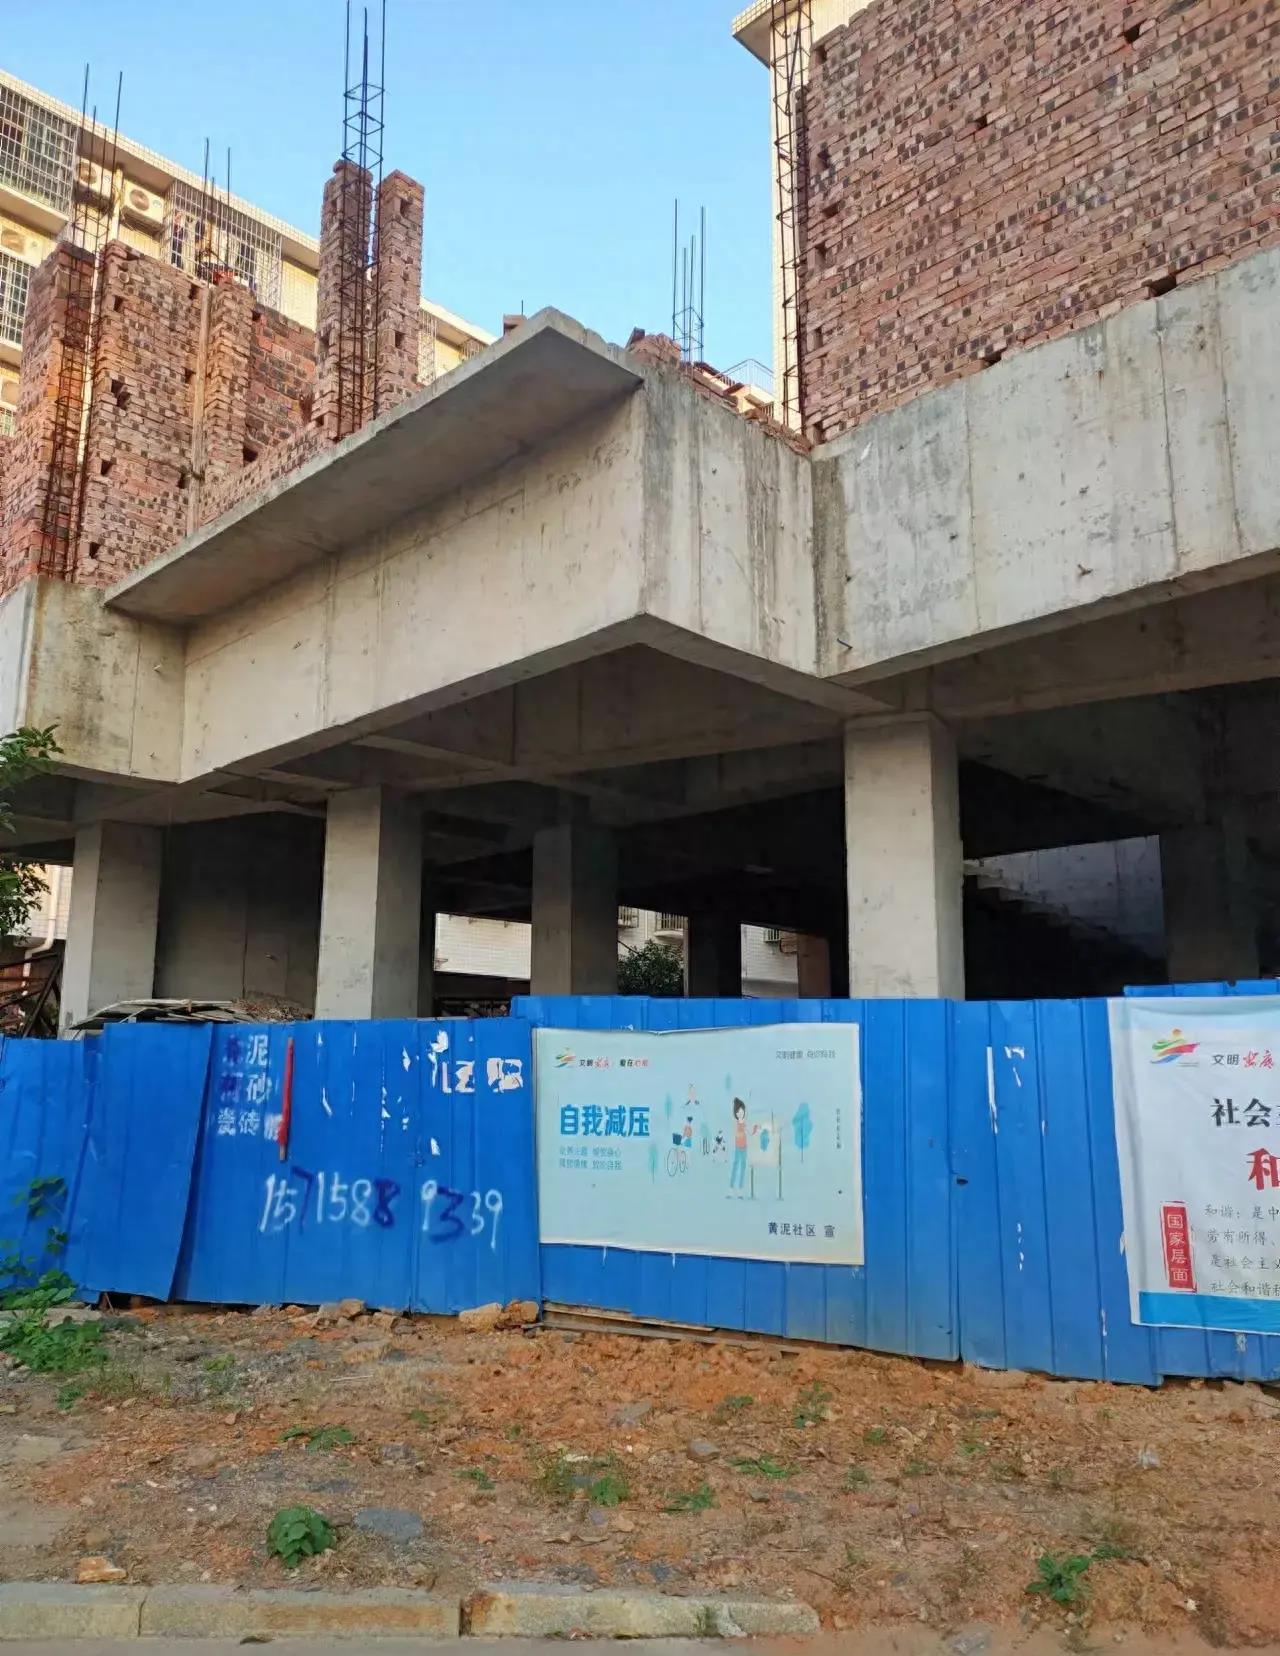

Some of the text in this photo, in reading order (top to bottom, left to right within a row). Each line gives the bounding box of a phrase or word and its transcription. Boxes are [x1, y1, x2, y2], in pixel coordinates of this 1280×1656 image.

[222, 1034, 269, 1066] 泥
[560, 1103, 651, 1138] 自我减压
[1210, 1098, 1280, 1128] 社会
[1246, 1147, 1280, 1191] 和
[421, 1179, 504, 1249] 9339
[768, 1221, 836, 1238] 黄泥社区 宣
[1166, 1214, 1190, 1281] 国家层面
